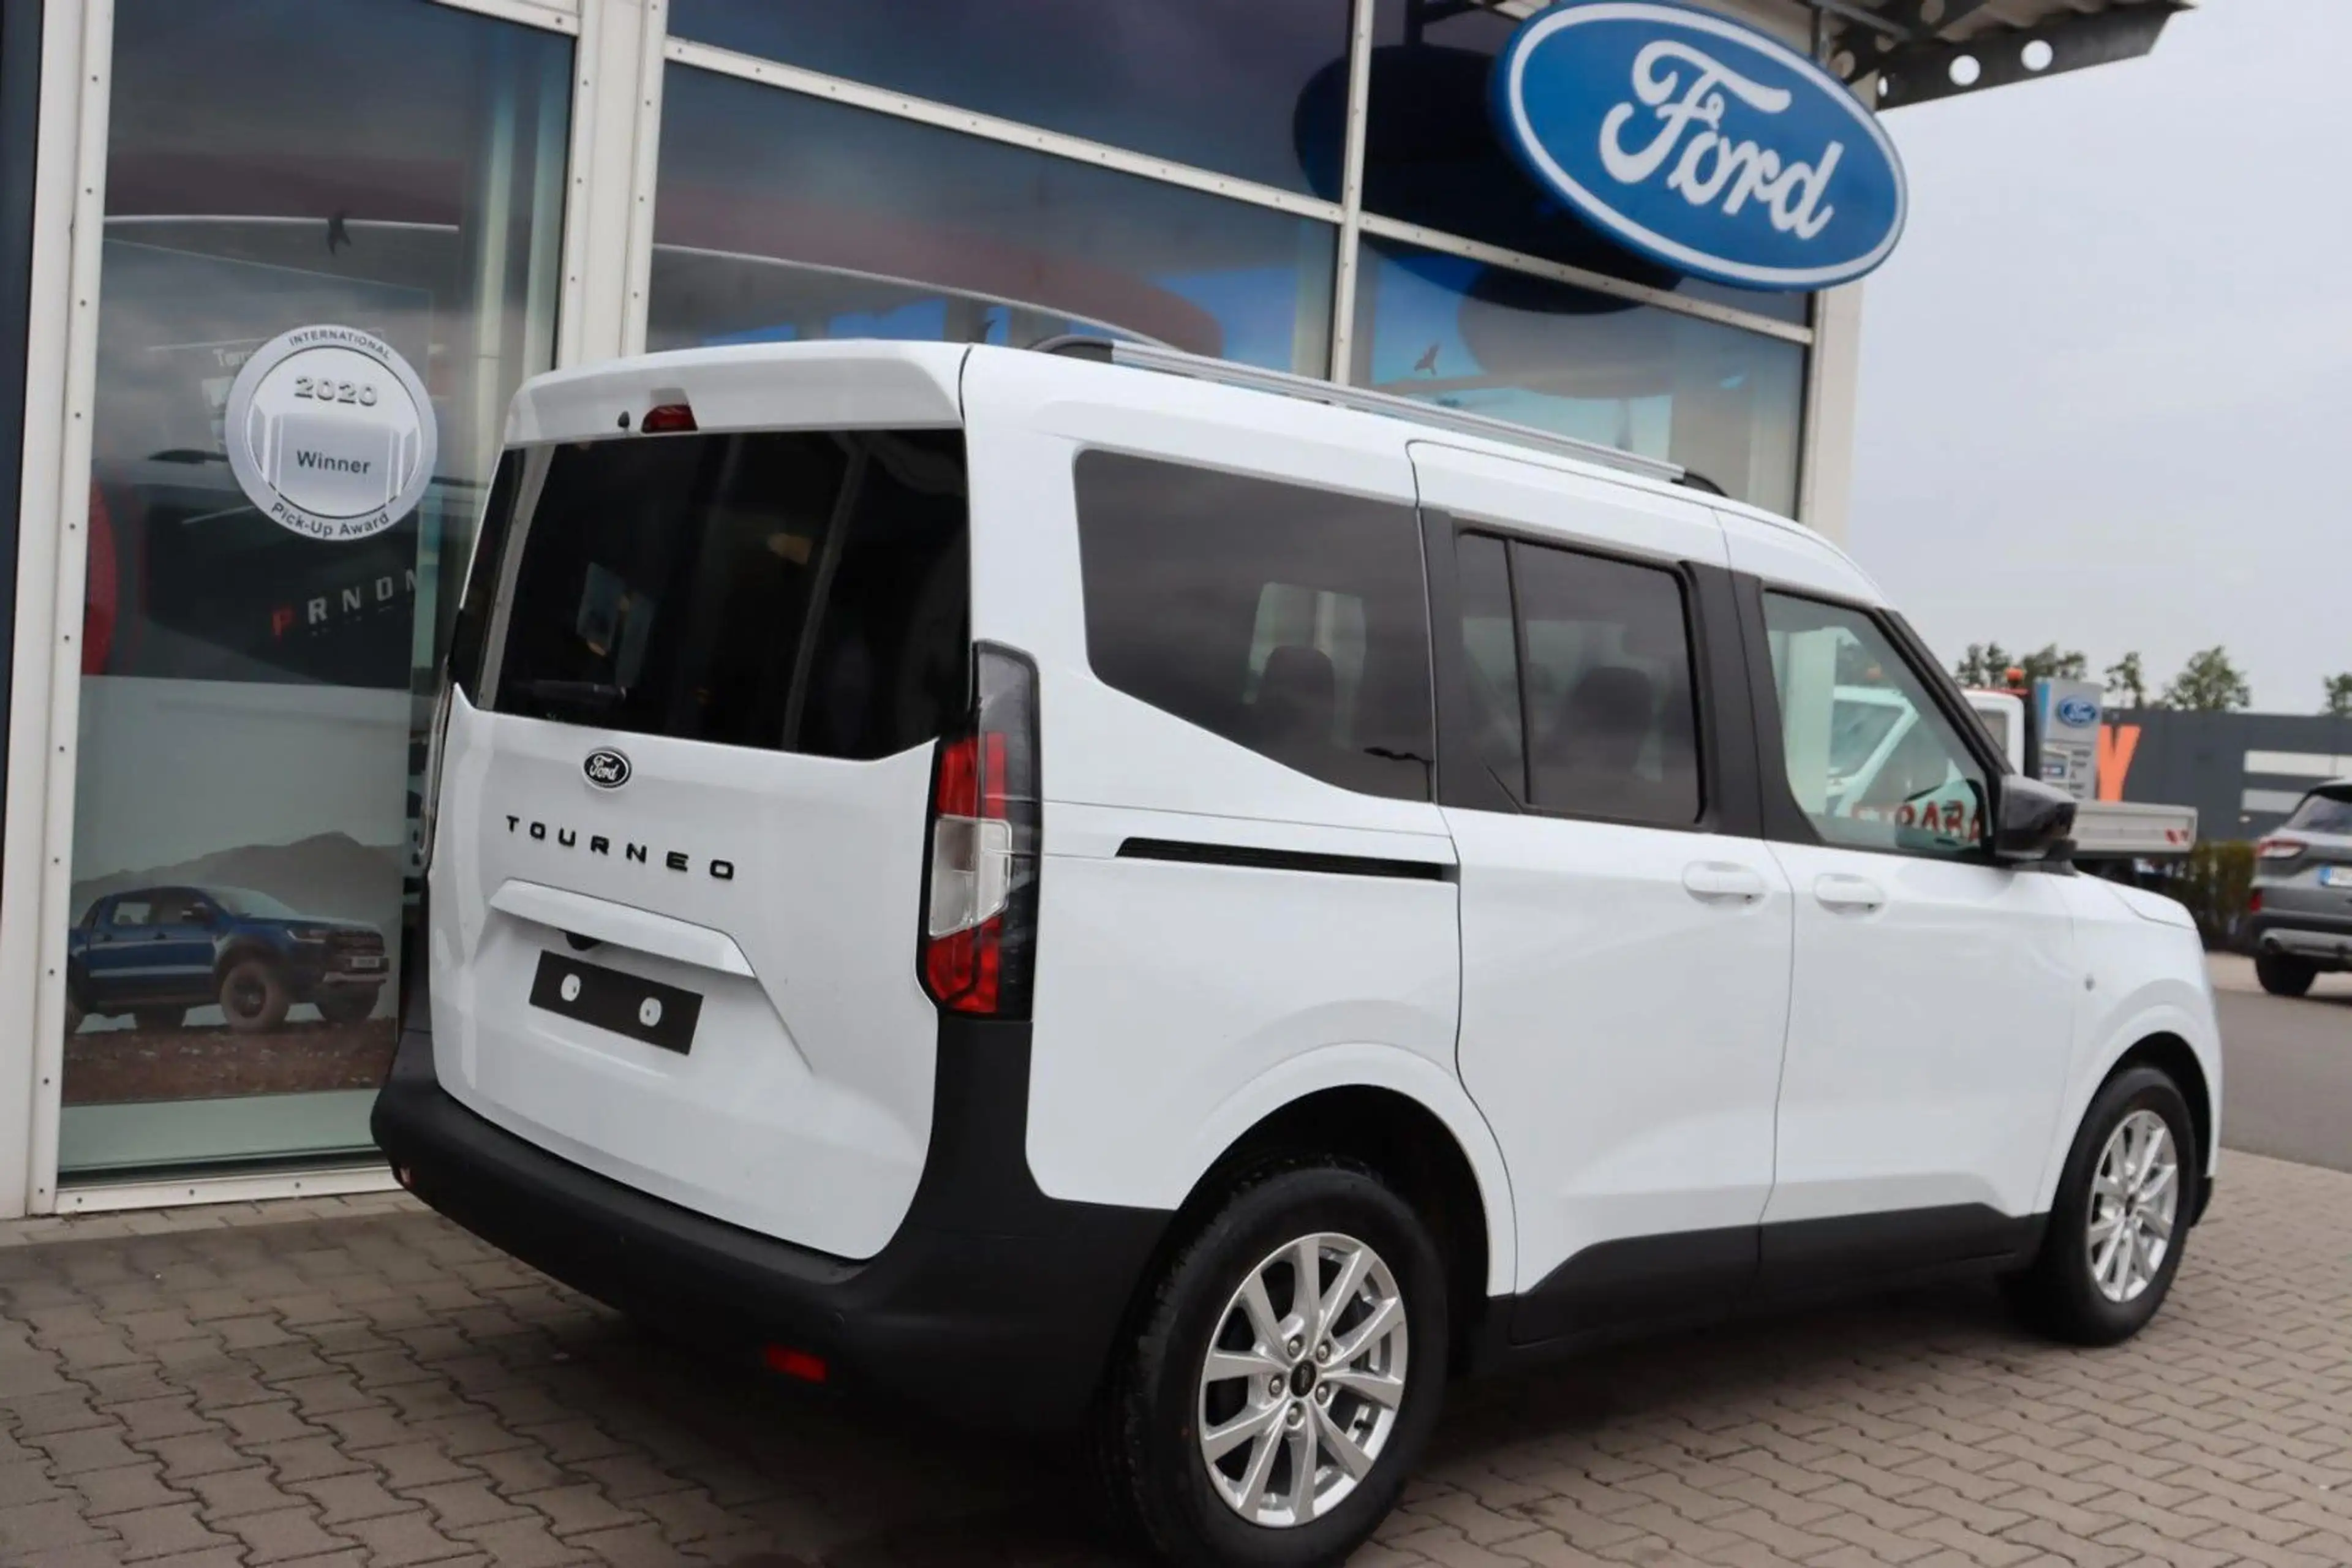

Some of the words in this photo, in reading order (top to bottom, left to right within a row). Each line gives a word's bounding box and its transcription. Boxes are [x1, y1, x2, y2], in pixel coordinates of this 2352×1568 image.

[1599, 39, 1844, 241] Ford
[289, 330, 390, 360] INTERNATIONAL
[294, 375, 378, 408] 2020
[296, 449, 371, 474] Winner
[271, 502, 334, 538] Pick-Up
[339, 511, 389, 537] Award
[589, 754, 620, 781] Ford
[505, 815, 735, 881] TOURNEO
